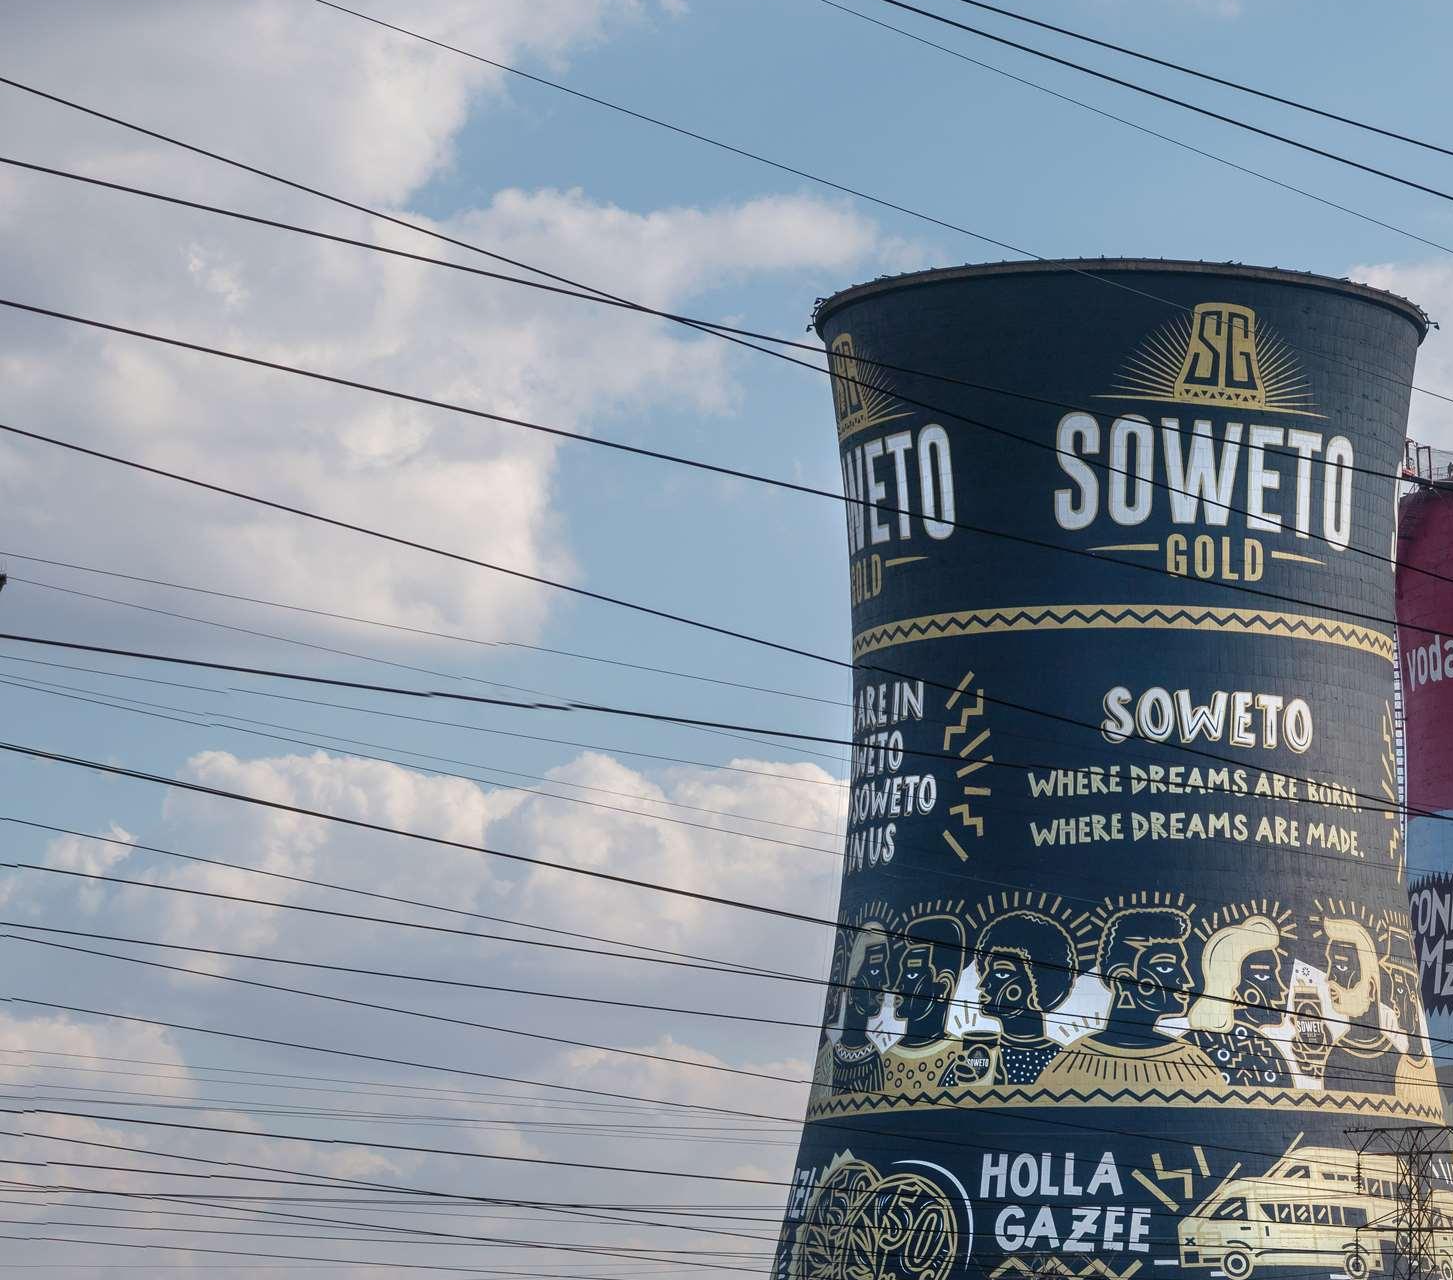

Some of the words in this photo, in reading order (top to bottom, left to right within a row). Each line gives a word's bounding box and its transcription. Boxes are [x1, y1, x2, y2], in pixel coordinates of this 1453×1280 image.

[1054, 411, 1354, 552] SOWETO
[1166, 533, 1263, 582] GOLD
[893, 678, 926, 724] IN
[1100, 686, 1313, 754] SOWETO
[1028, 766, 1122, 798] WHERE
[1131, 765, 1248, 798] DREAMS
[1254, 772, 1297, 803] ARE
[868, 823, 897, 866] US
[1029, 813, 1124, 847] WHERE
[1132, 812, 1248, 842] DREAMS
[1255, 816, 1300, 847] ARE
[1307, 822, 1365, 858] MADE.
[1297, 1020, 1322, 1033] SOWET
[979, 1151, 1124, 1199] HOLLA
[995, 1205, 1151, 1253] GAZEE
